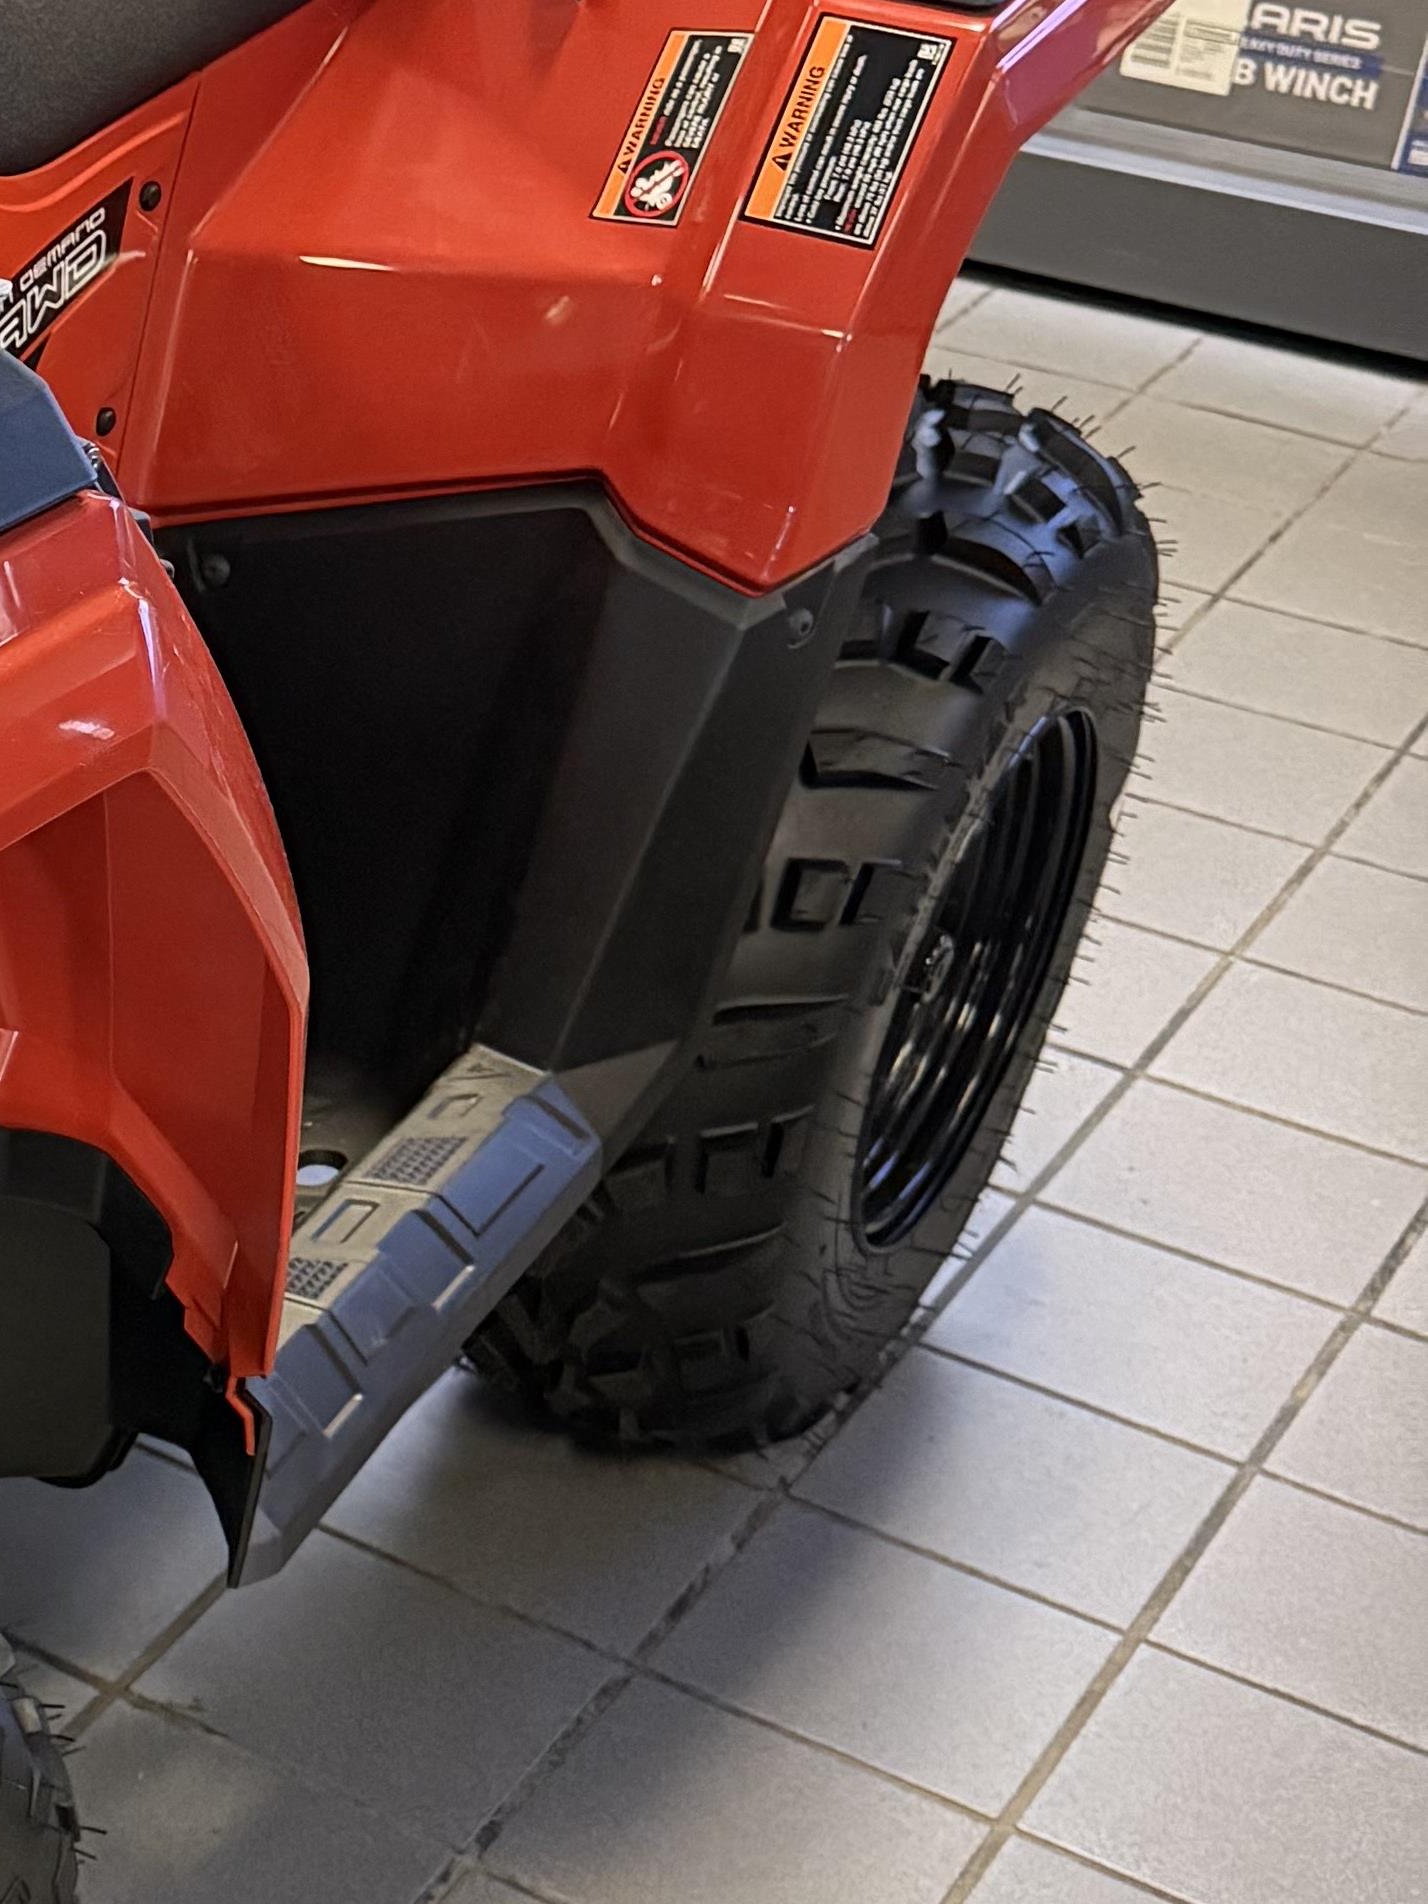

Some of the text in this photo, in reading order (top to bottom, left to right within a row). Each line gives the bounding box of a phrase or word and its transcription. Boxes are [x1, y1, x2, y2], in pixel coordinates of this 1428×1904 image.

[1251, 2, 1382, 51] ARIS
[623, 77, 665, 160] WARNING
[781, 65, 825, 149] WARNING
[1266, 61, 1380, 111] WINCH
